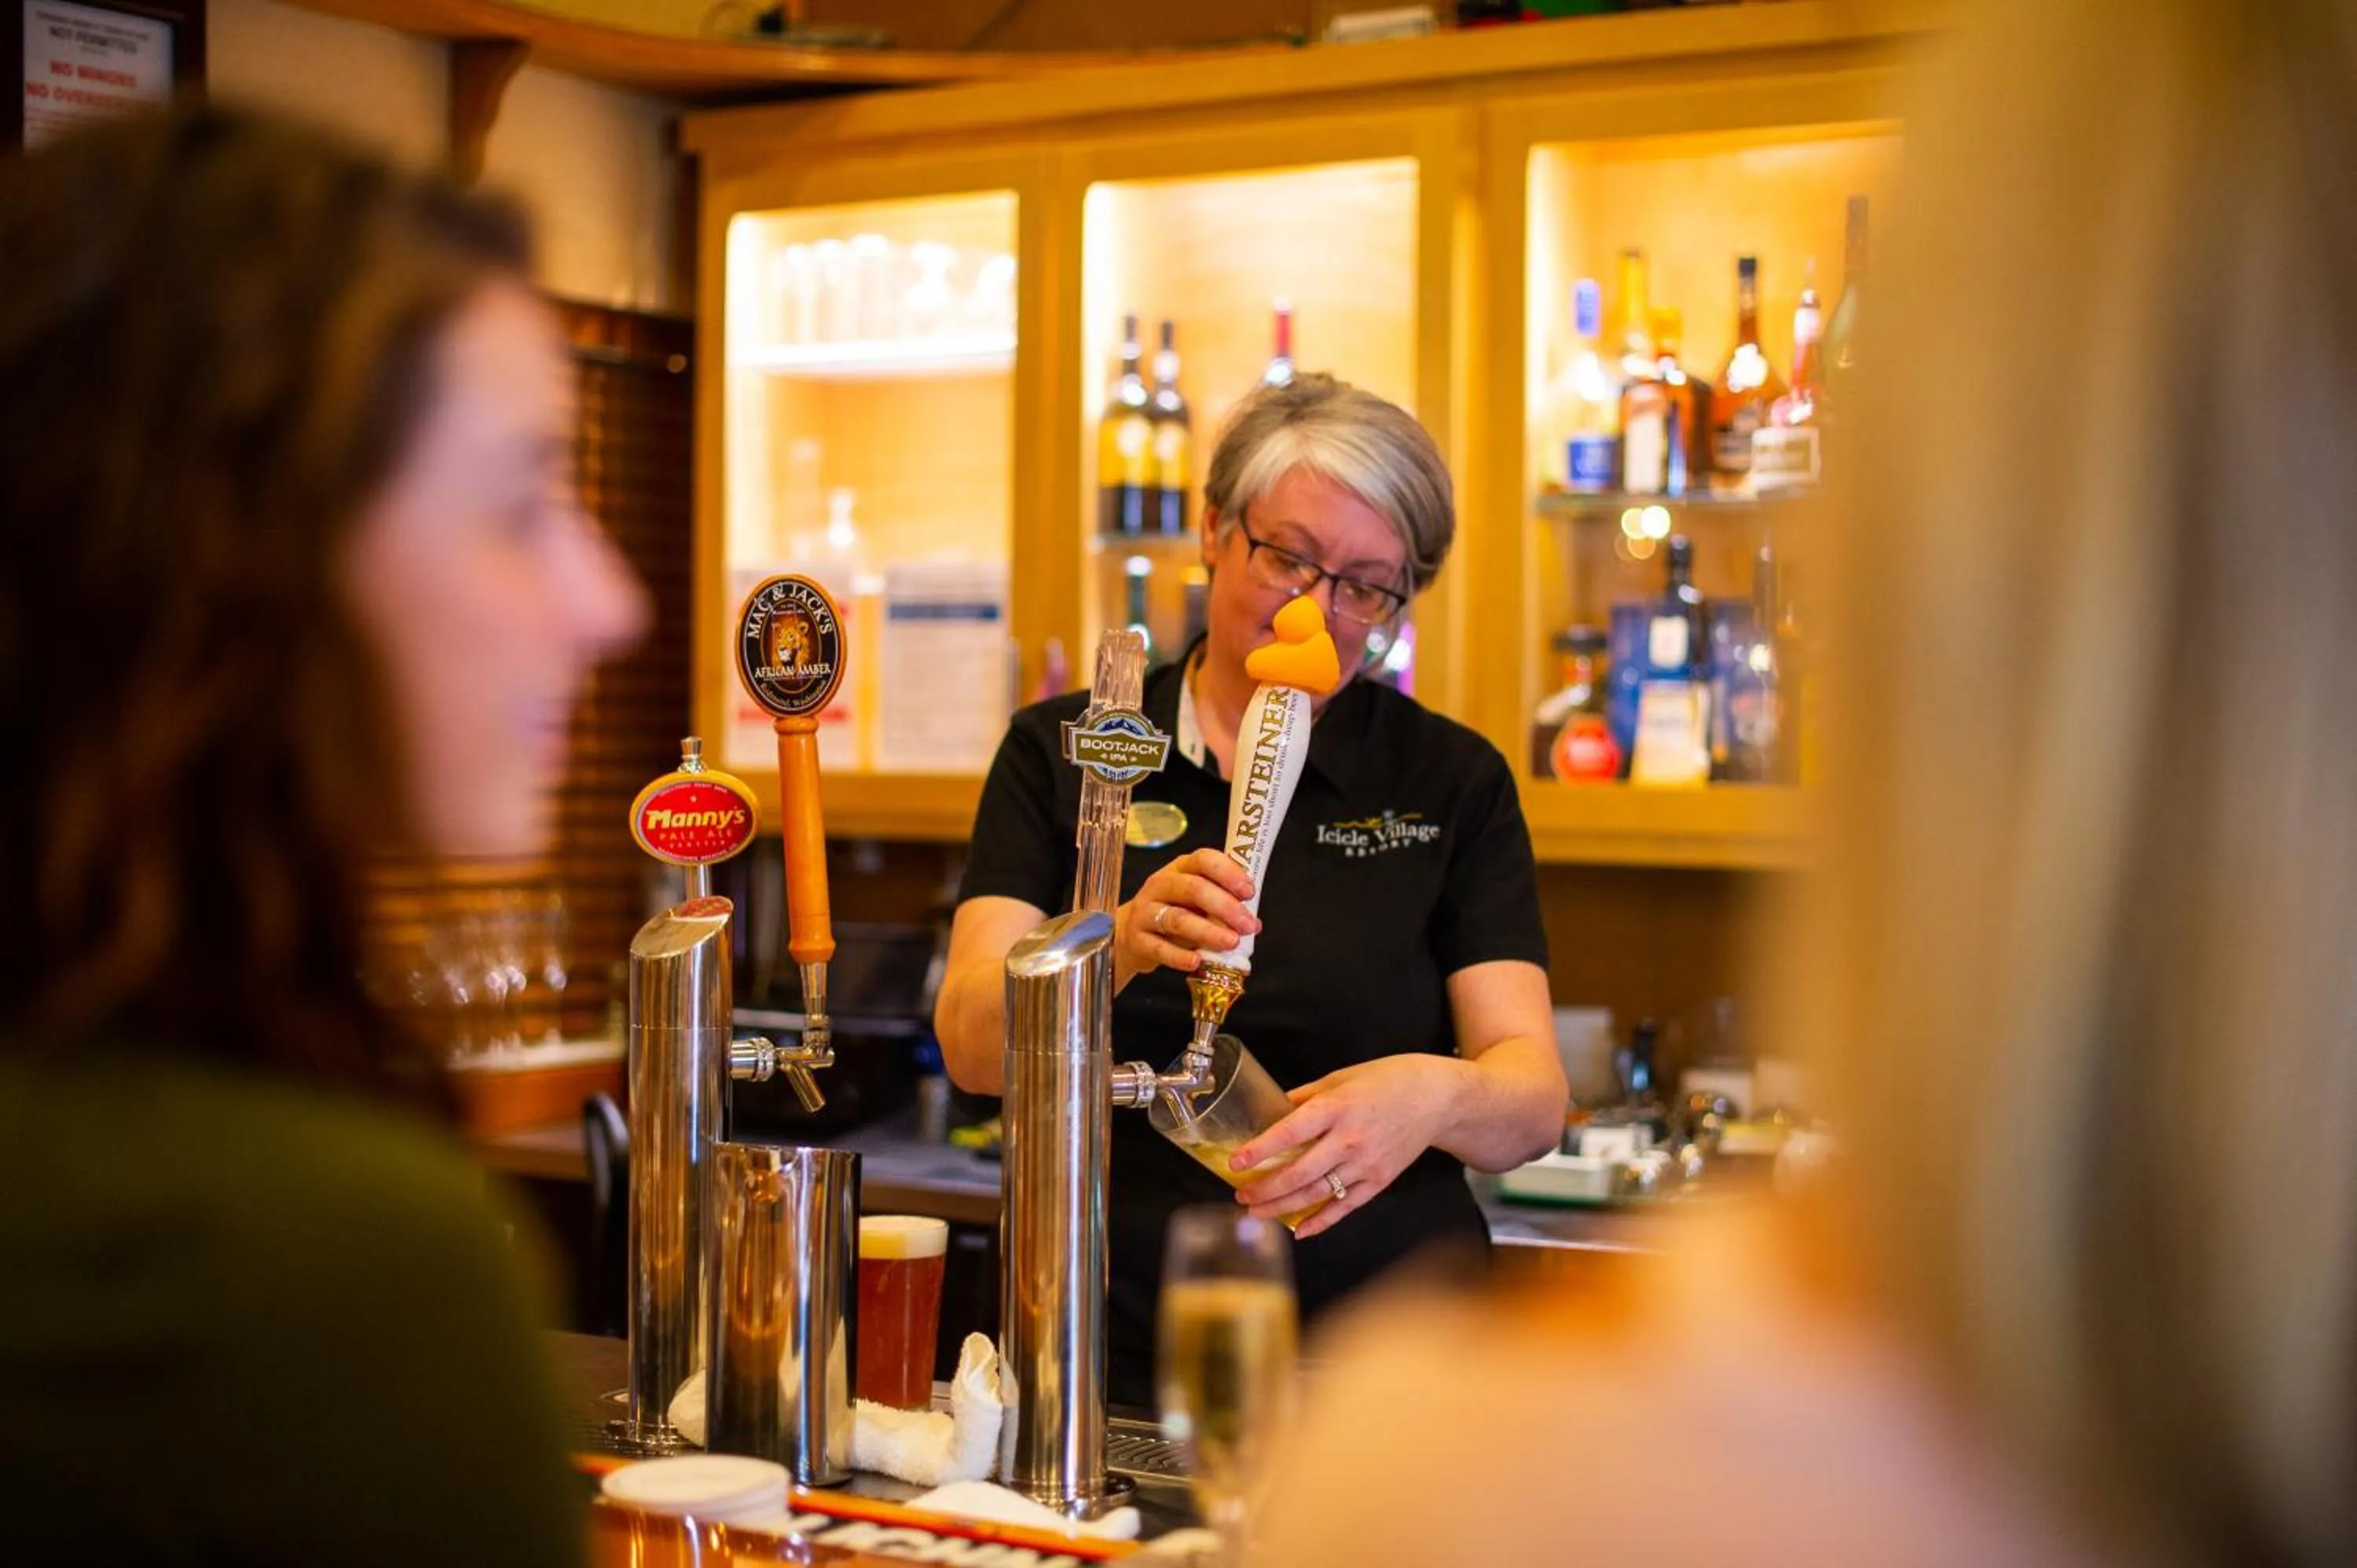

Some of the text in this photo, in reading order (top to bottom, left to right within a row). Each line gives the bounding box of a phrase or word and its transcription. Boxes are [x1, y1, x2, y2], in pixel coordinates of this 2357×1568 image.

[50, 60, 72, 76] NO
[26, 82, 49, 98] NO
[747, 583, 834, 639] MAC & JACK'S
[755, 665, 795, 679] AFRICAN
[797, 664, 831, 677] AMBER
[1080, 738, 1160, 755] BOOTJACK
[1109, 753, 1128, 763] IPA
[1227, 688, 1290, 872] ARSTEINER
[646, 806, 746, 830] Manny's
[1317, 822, 1440, 846] Icicle Village
